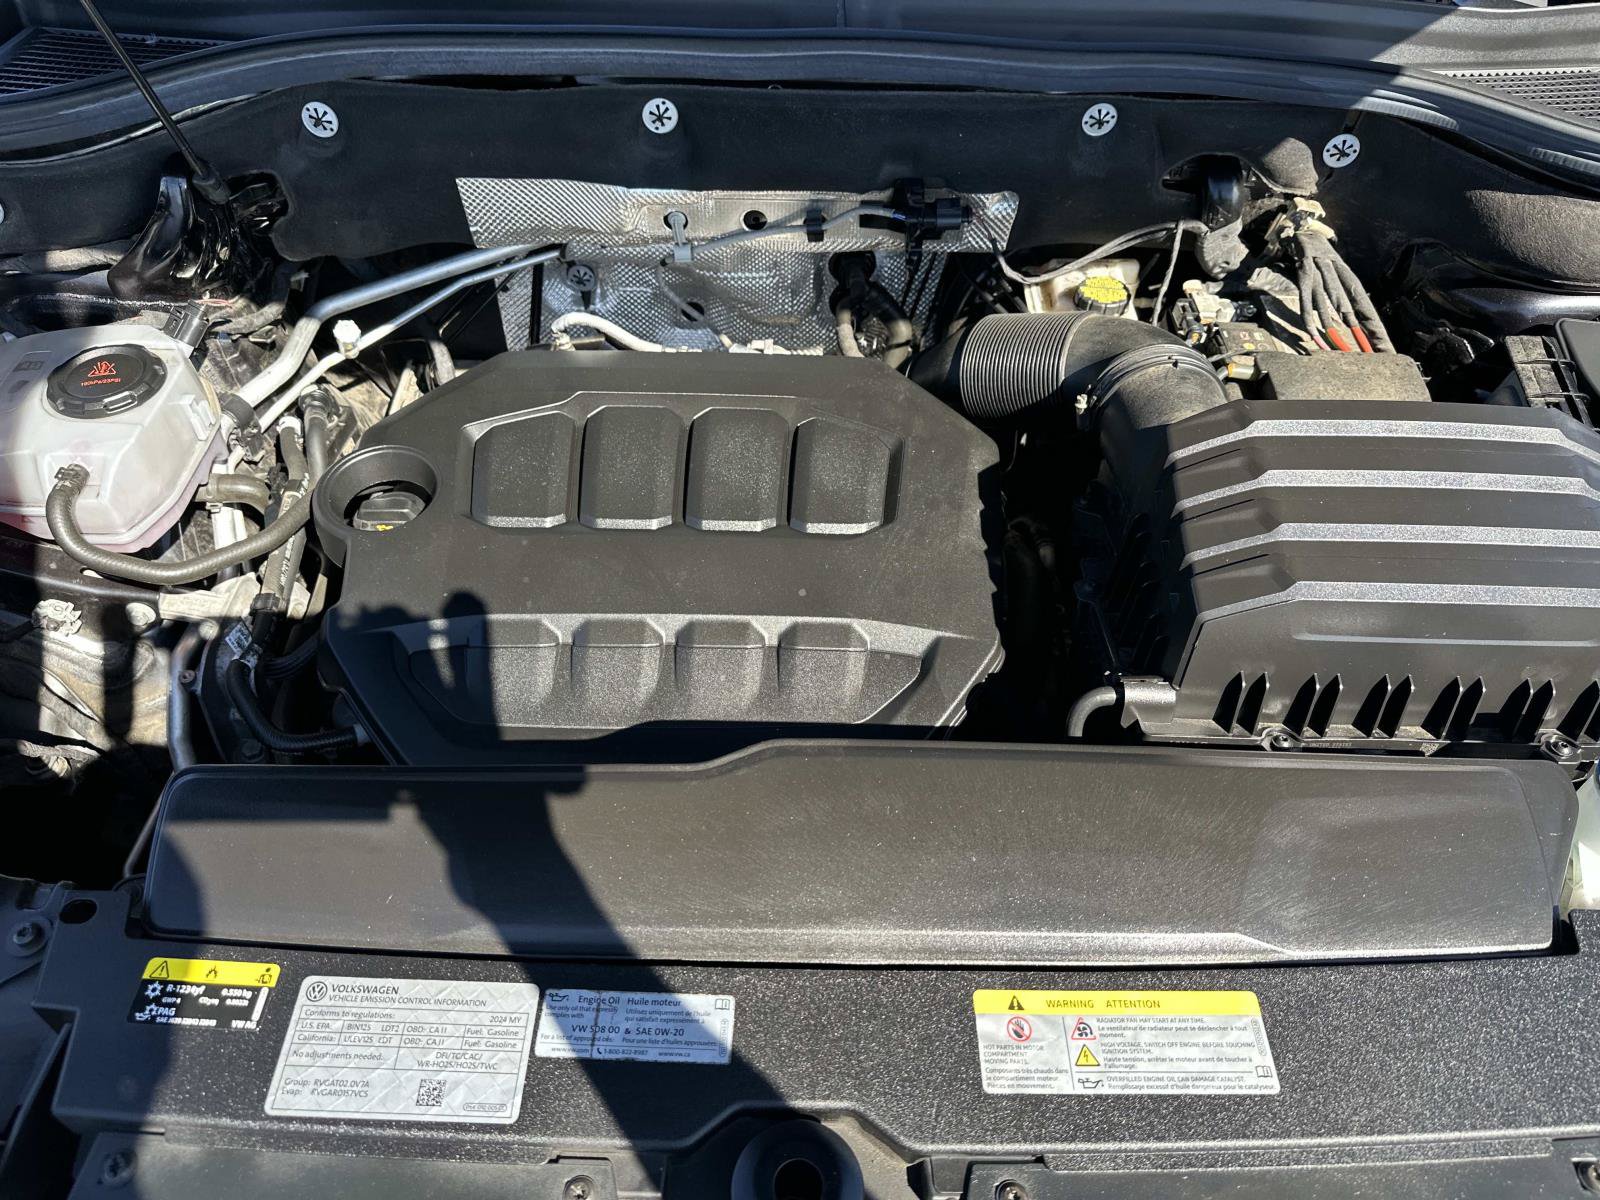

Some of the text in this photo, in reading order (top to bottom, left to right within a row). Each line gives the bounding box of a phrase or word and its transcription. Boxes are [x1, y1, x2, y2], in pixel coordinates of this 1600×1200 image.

[332, 984, 400, 994] VOLKSWAGEN
[434, 998, 487, 1007] INFORMATION
[578, 996, 620, 1006] Engine Oil
[627, 997, 649, 1006] Huile
[1046, 1000, 1161, 1008] WARNING ATTENTION
[305, 1008, 339, 1017] Conforms
[351, 1010, 395, 1019] regulations:
[489, 1015, 522, 1024] 2024 MY
[231, 1020, 257, 1029] VW AG
[381, 1024, 400, 1032] LDT2
[487, 1028, 519, 1036] Gasoline
[654, 1028, 685, 1036] 0W-20
[297, 1034, 336, 1042] California:
[305, 1050, 352, 1060] adjustments
[353, 1052, 383, 1060] needed.
[435, 1051, 483, 1060] DFI/TC/CAC/
[285, 1078, 310, 1087] Group:
